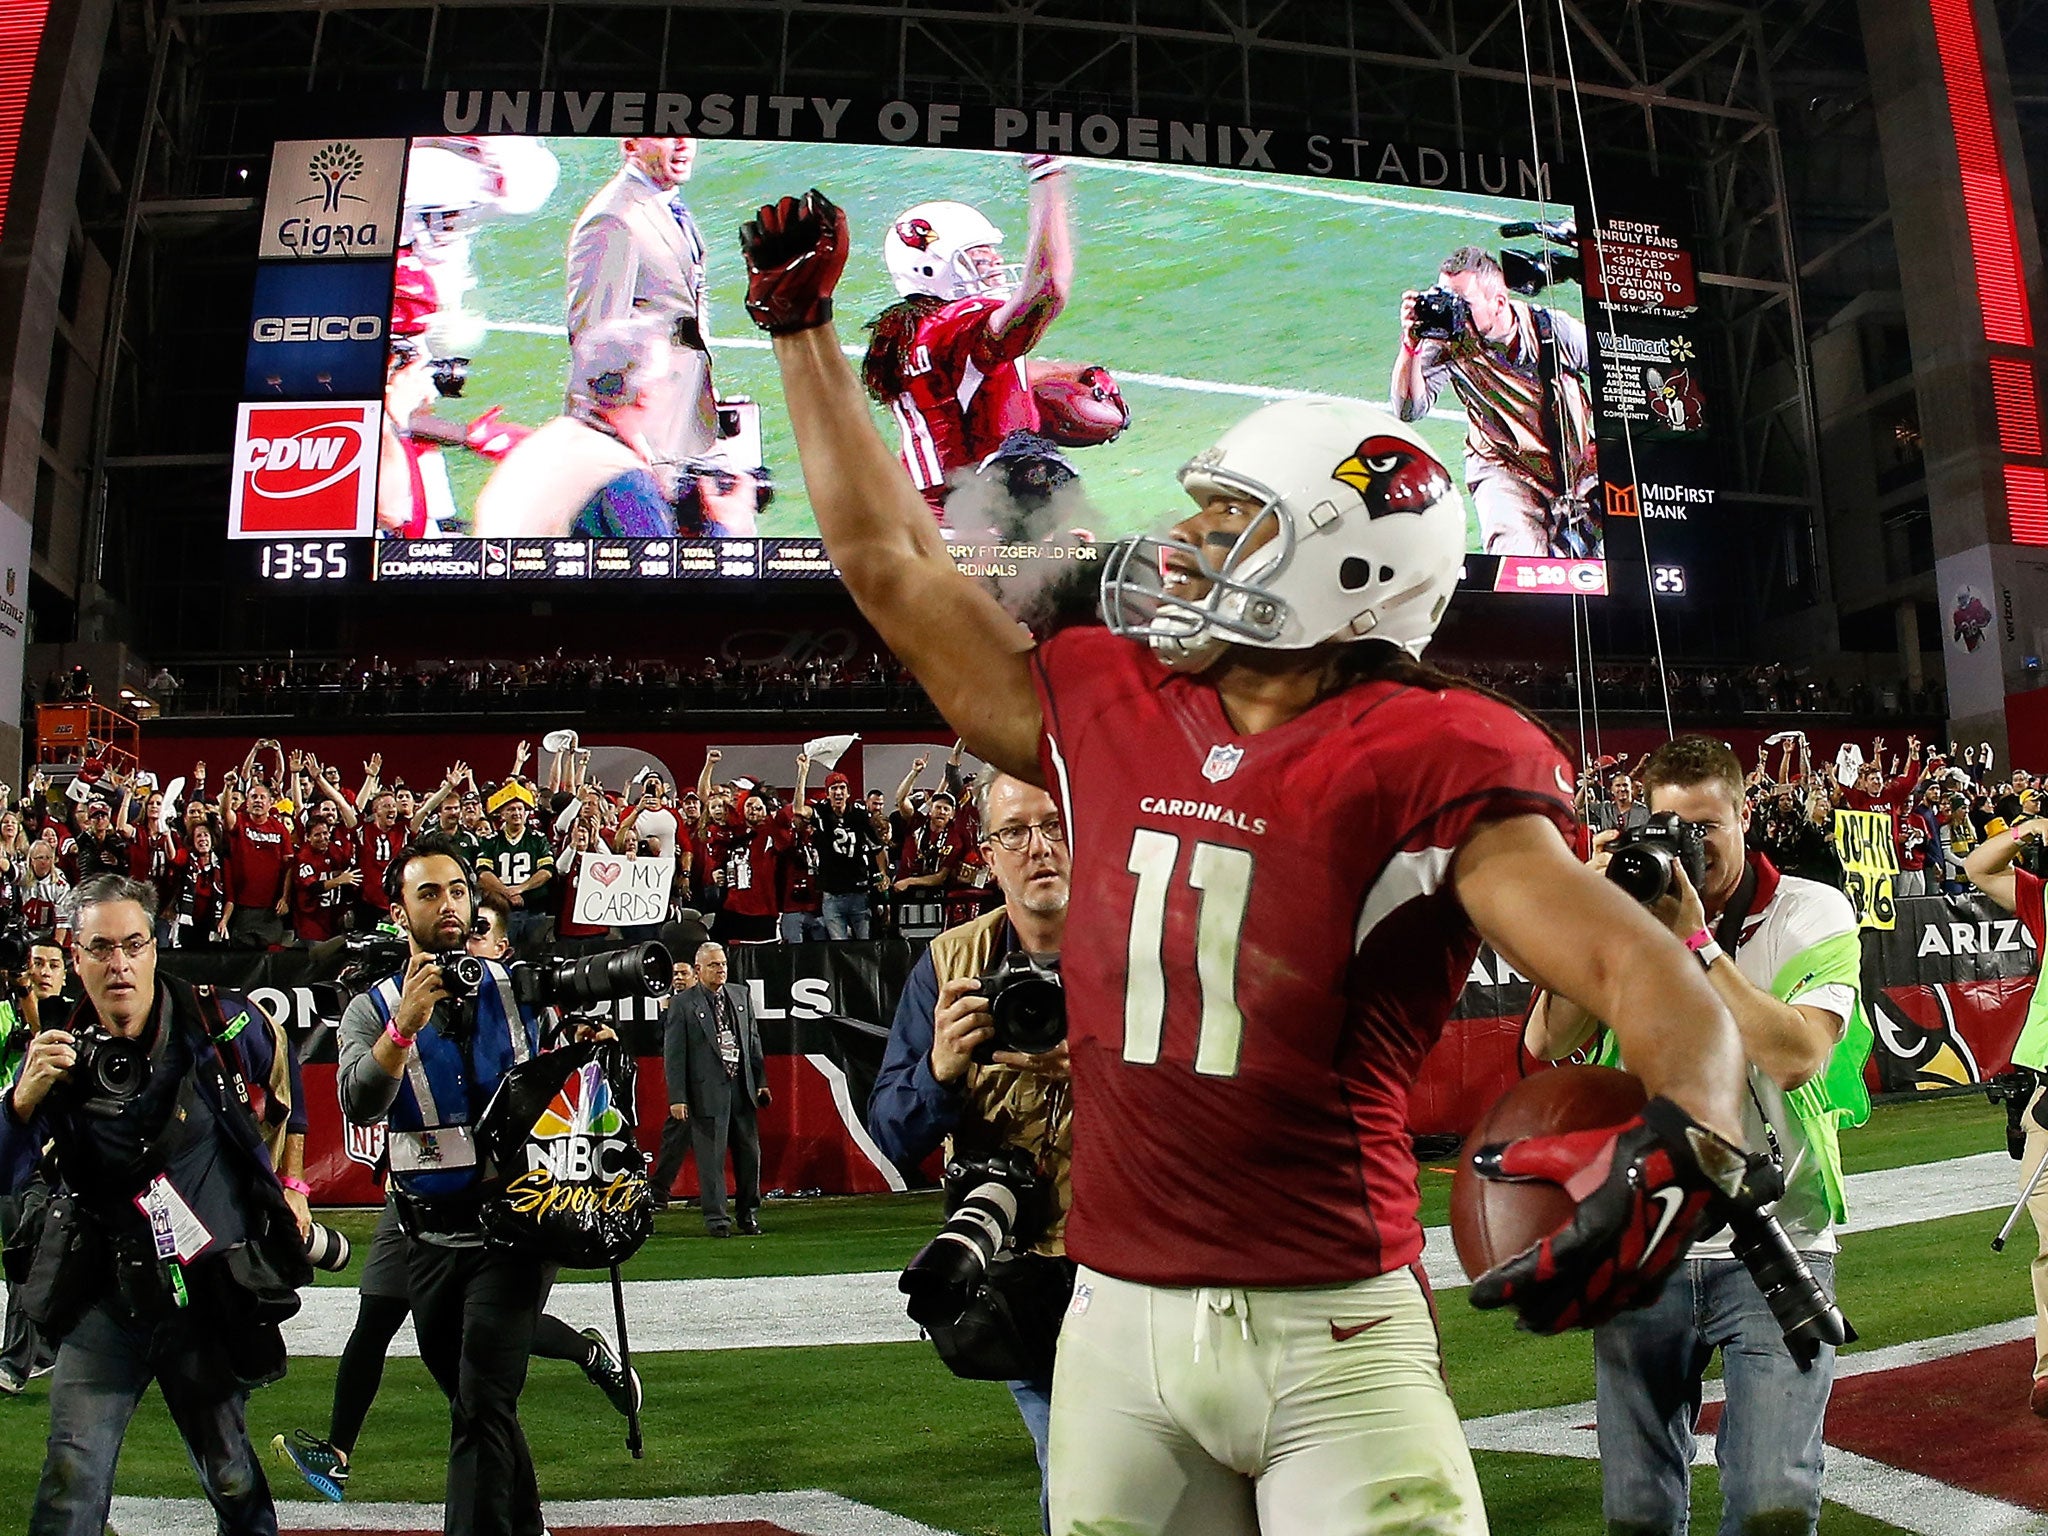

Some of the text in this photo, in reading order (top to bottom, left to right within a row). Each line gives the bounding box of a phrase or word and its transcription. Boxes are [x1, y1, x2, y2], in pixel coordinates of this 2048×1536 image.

[443, 91, 1551, 200] UNIVERSITY OF PHOENIX STADIUM
[278, 218, 377, 254] Cigna
[1593, 228, 1679, 249] UNRULY FANS
[1609, 219, 1660, 236] REPORT
[1606, 264, 1672, 281] ISSUE AND
[1612, 256, 1665, 269] <SPACE>
[1599, 273, 1682, 293] LOCATION TO
[1620, 288, 1664, 302] 69050
[252, 315, 382, 342] GEICO
[1597, 332, 1669, 356] Walmart
[245, 437, 347, 471] CDW
[261, 542, 347, 579] 13:55
[408, 543, 453, 557] GAME
[1067, 547, 1097, 560] FOR
[381, 561, 479, 576] COMPARISON
[1536, 565, 1566, 585] 20
[1654, 567, 1684, 592] 25
[1140, 797, 1268, 836] CARDINALS
[375, 836, 392, 861] 11
[1839, 814, 1896, 870] JOHN
[498, 851, 532, 885] 12
[630, 863, 669, 888] MY
[583, 891, 662, 922] CARDS
[1122, 827, 1255, 1078] 11
[526, 1136, 629, 1182] NBC
[505, 1167, 645, 1225] Sports
